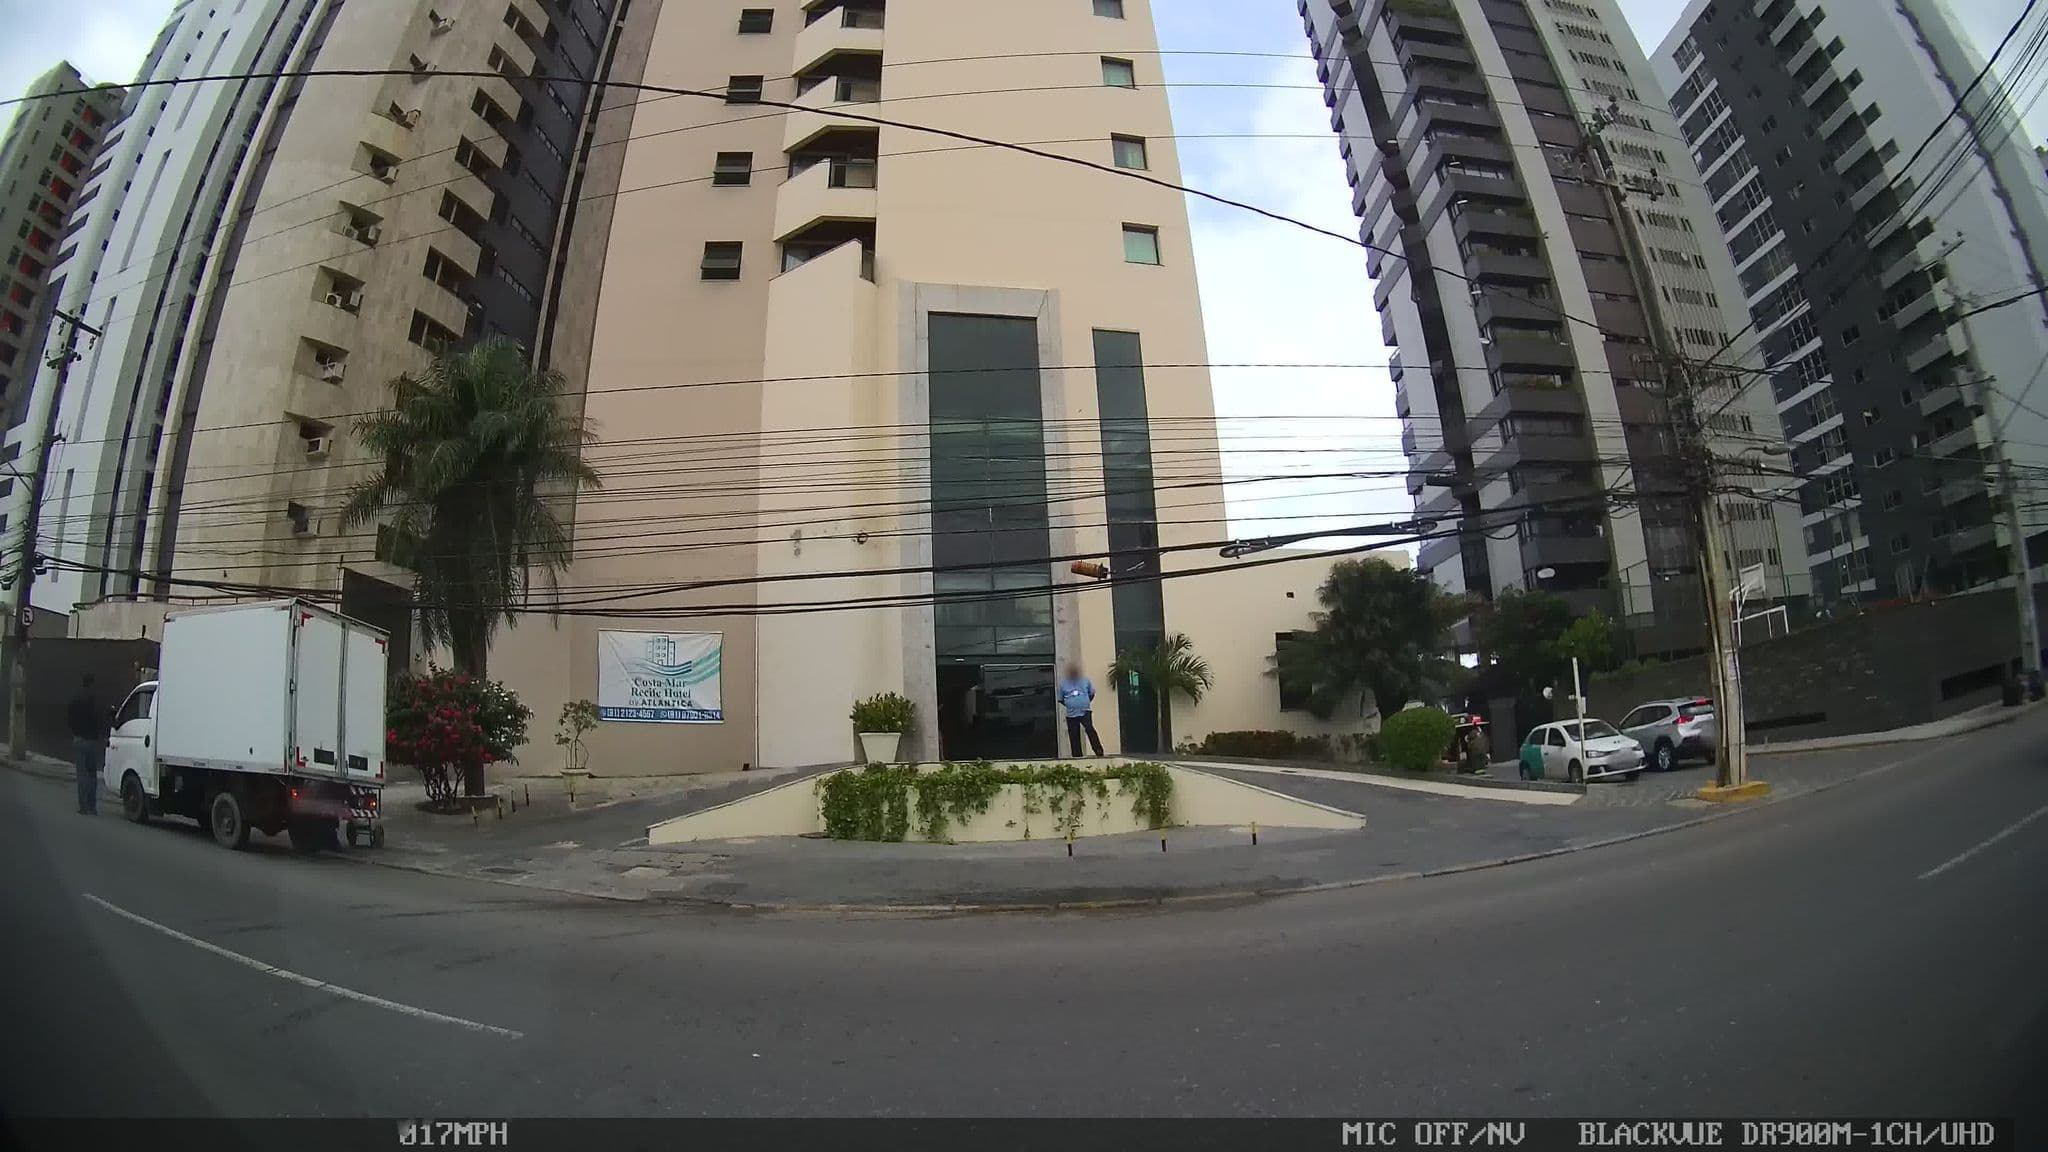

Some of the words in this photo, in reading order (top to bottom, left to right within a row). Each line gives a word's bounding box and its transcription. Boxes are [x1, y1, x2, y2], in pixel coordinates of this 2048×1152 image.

[634, 678, 662, 687] Costa
[666, 678, 686, 687] Mar
[631, 687, 662, 698] Recife
[664, 688, 691, 699] Hotel
[641, 699, 694, 708] ATLANTICA
